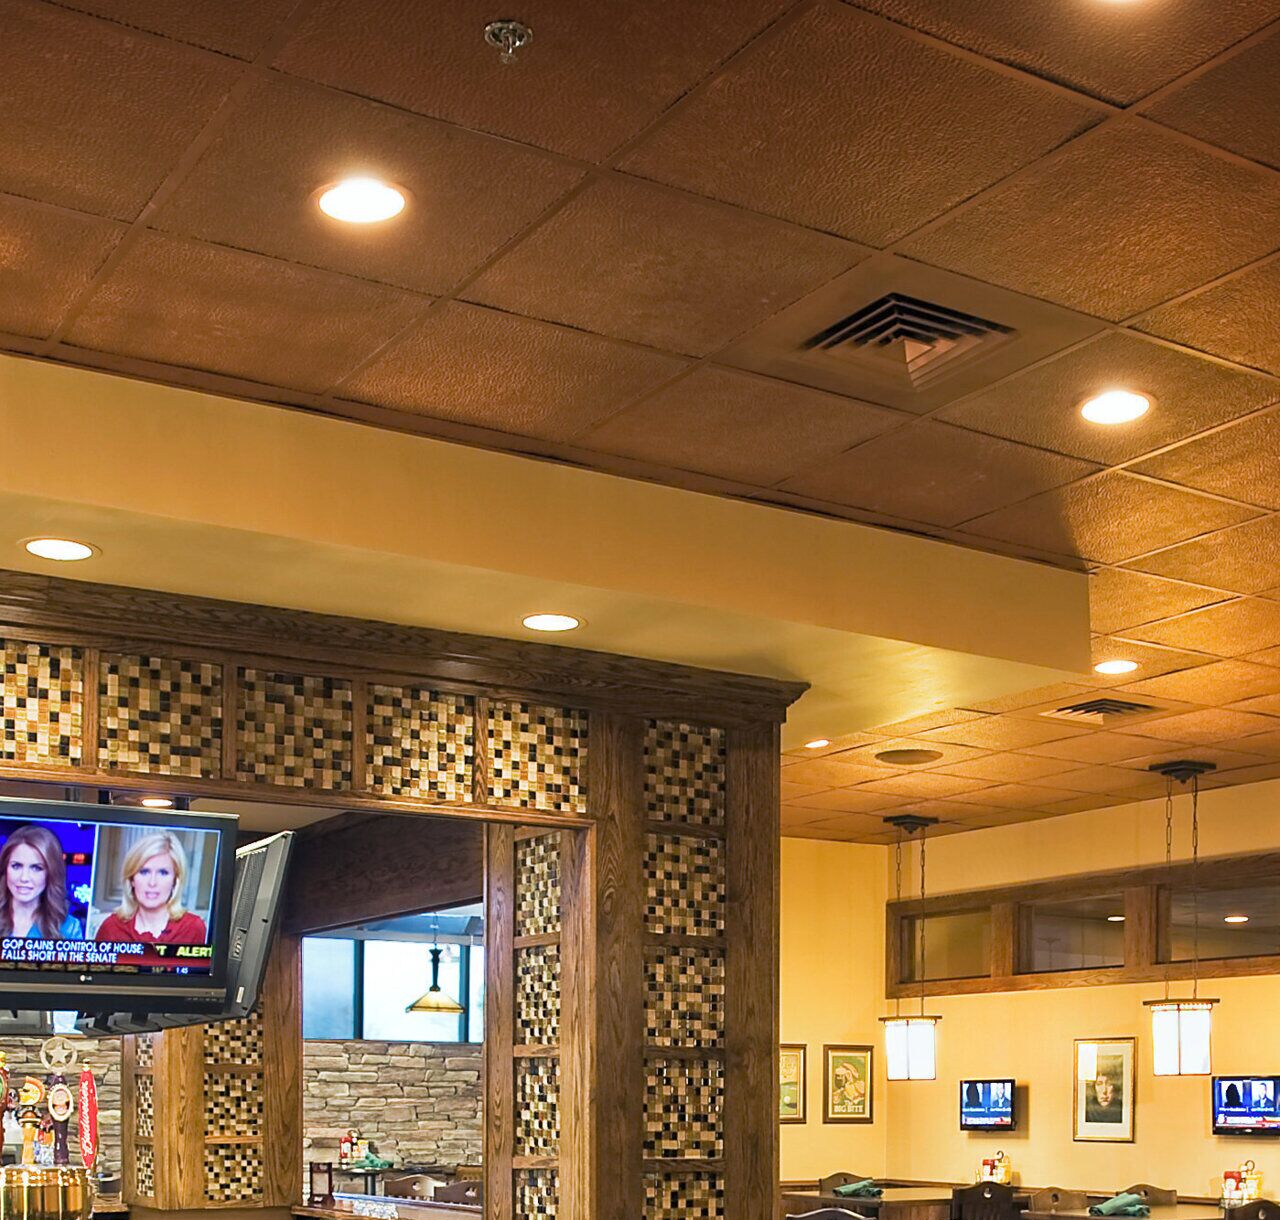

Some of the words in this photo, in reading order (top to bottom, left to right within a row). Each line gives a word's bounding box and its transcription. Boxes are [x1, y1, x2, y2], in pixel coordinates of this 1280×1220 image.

[2, 938, 24, 949] GOP
[25, 939, 54, 950] GAINS
[55, 940, 98, 952] CONTROL
[99, 942, 112, 952] OF
[113, 943, 144, 954] HOUSE;
[176, 946, 212, 957] ALERT
[1, 949, 26, 960] FALLS
[26, 950, 57, 961] SHORT
[57, 951, 68, 961] IN
[69, 952, 84, 962] THE
[85, 953, 117, 963] SENATE
[81, 1080, 93, 1157] Budweiser
